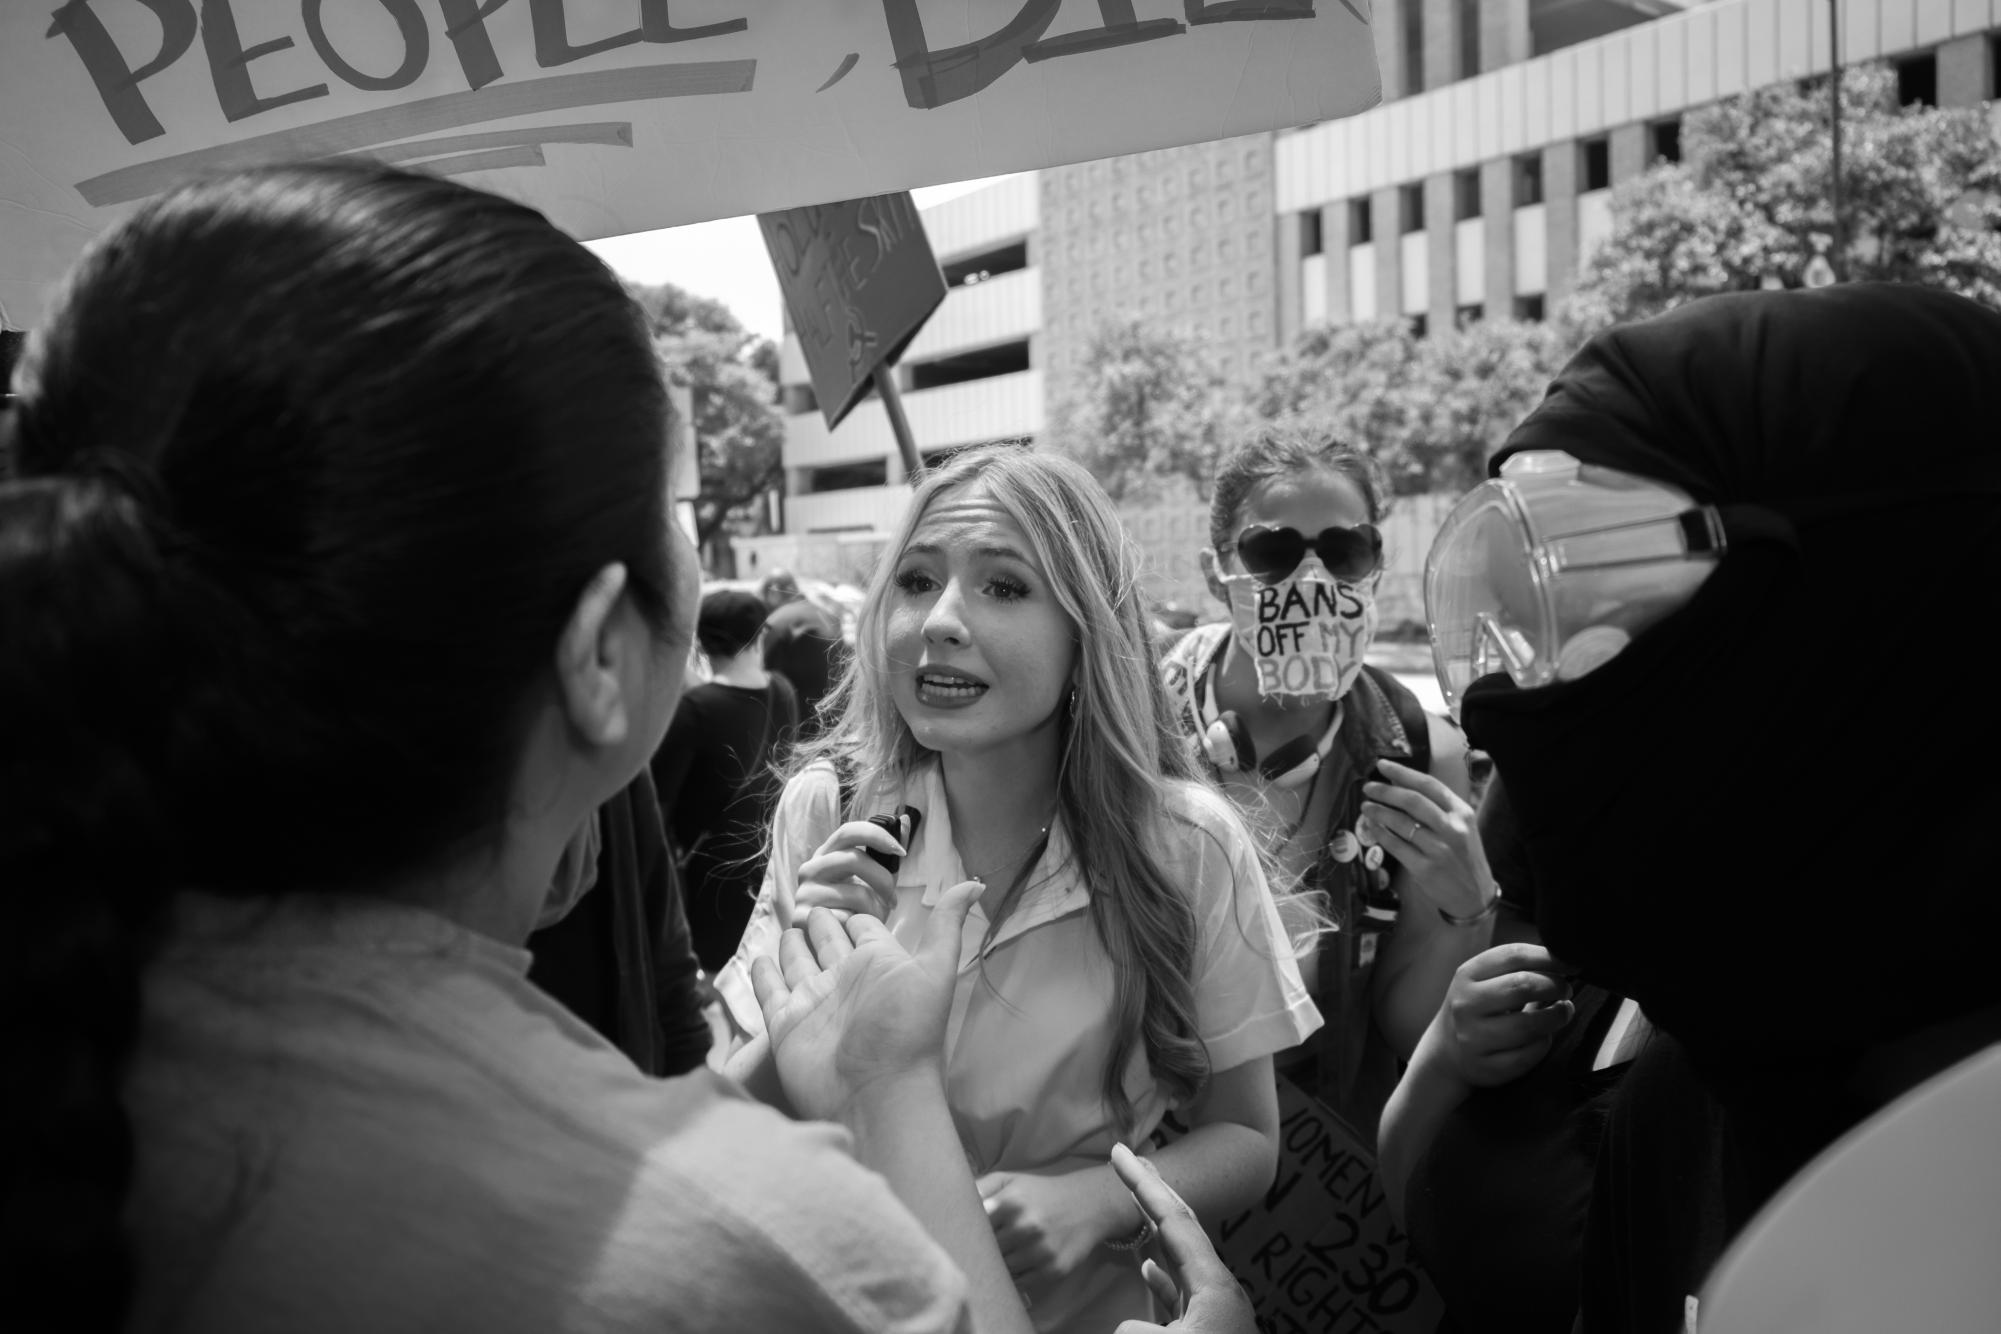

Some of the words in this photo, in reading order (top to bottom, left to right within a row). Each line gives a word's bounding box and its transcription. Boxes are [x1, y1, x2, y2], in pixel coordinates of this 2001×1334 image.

[1258, 581, 1364, 623] BANS
[1257, 621, 1310, 657] OFF
[1318, 620, 1365, 659] MY
[1257, 654, 1358, 699] BODY
[1250, 1230, 1394, 1334] RIGHT
[1304, 1211, 1420, 1315] 230
